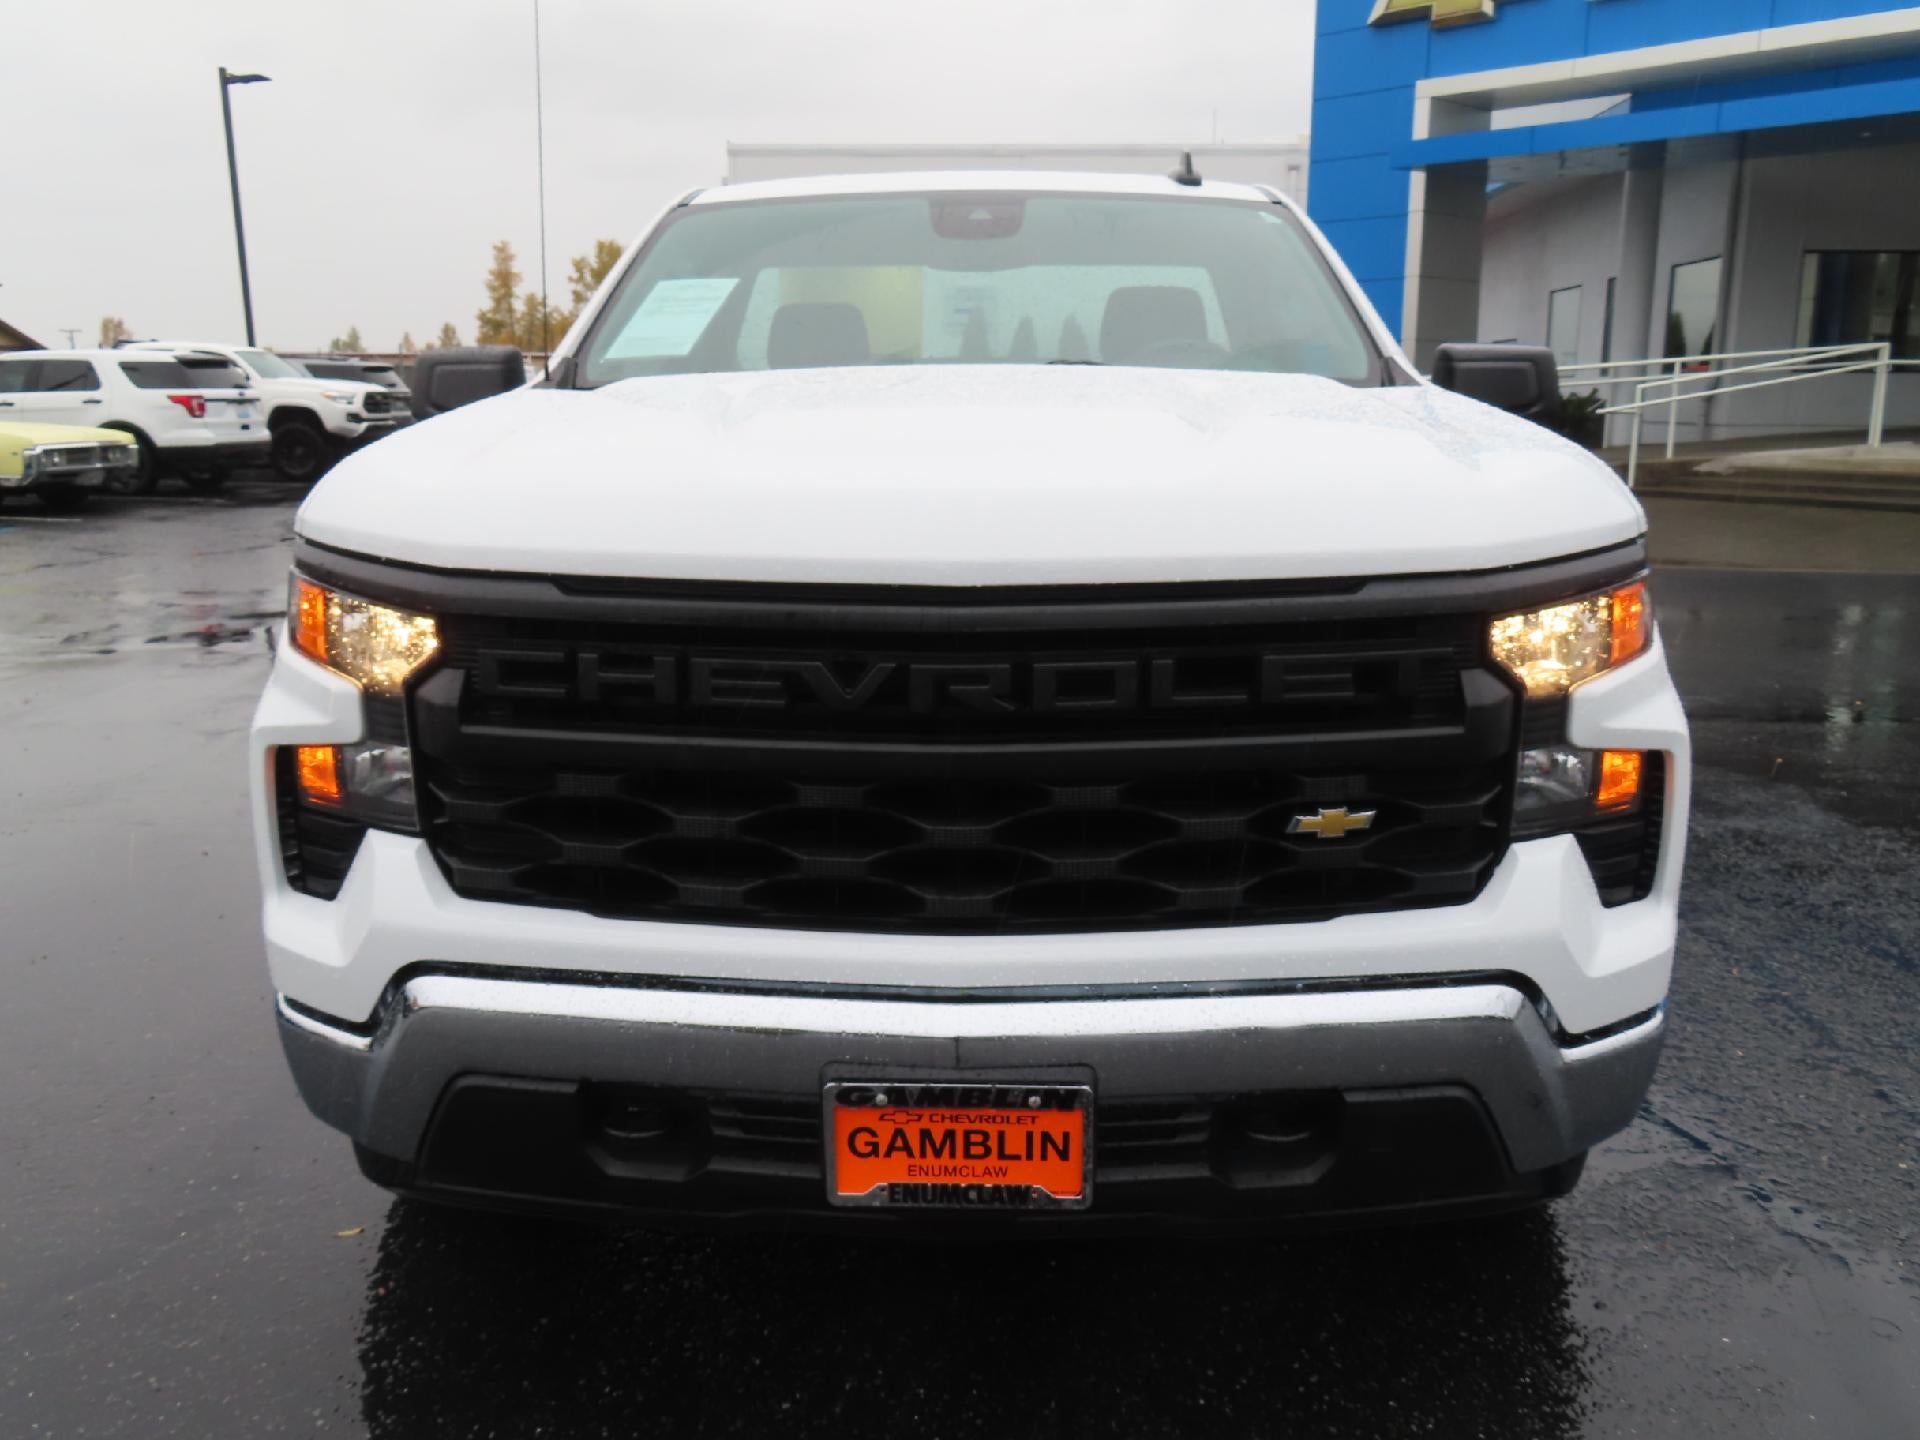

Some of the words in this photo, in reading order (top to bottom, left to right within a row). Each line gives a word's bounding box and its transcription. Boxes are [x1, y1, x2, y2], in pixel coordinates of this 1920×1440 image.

[477, 646, 1454, 712] CHEVROLET
[928, 1113, 1039, 1125] CHEVROLET
[847, 1126, 1070, 1162] GAMBLIN
[908, 1164, 1008, 1178] ENUMCLAW
